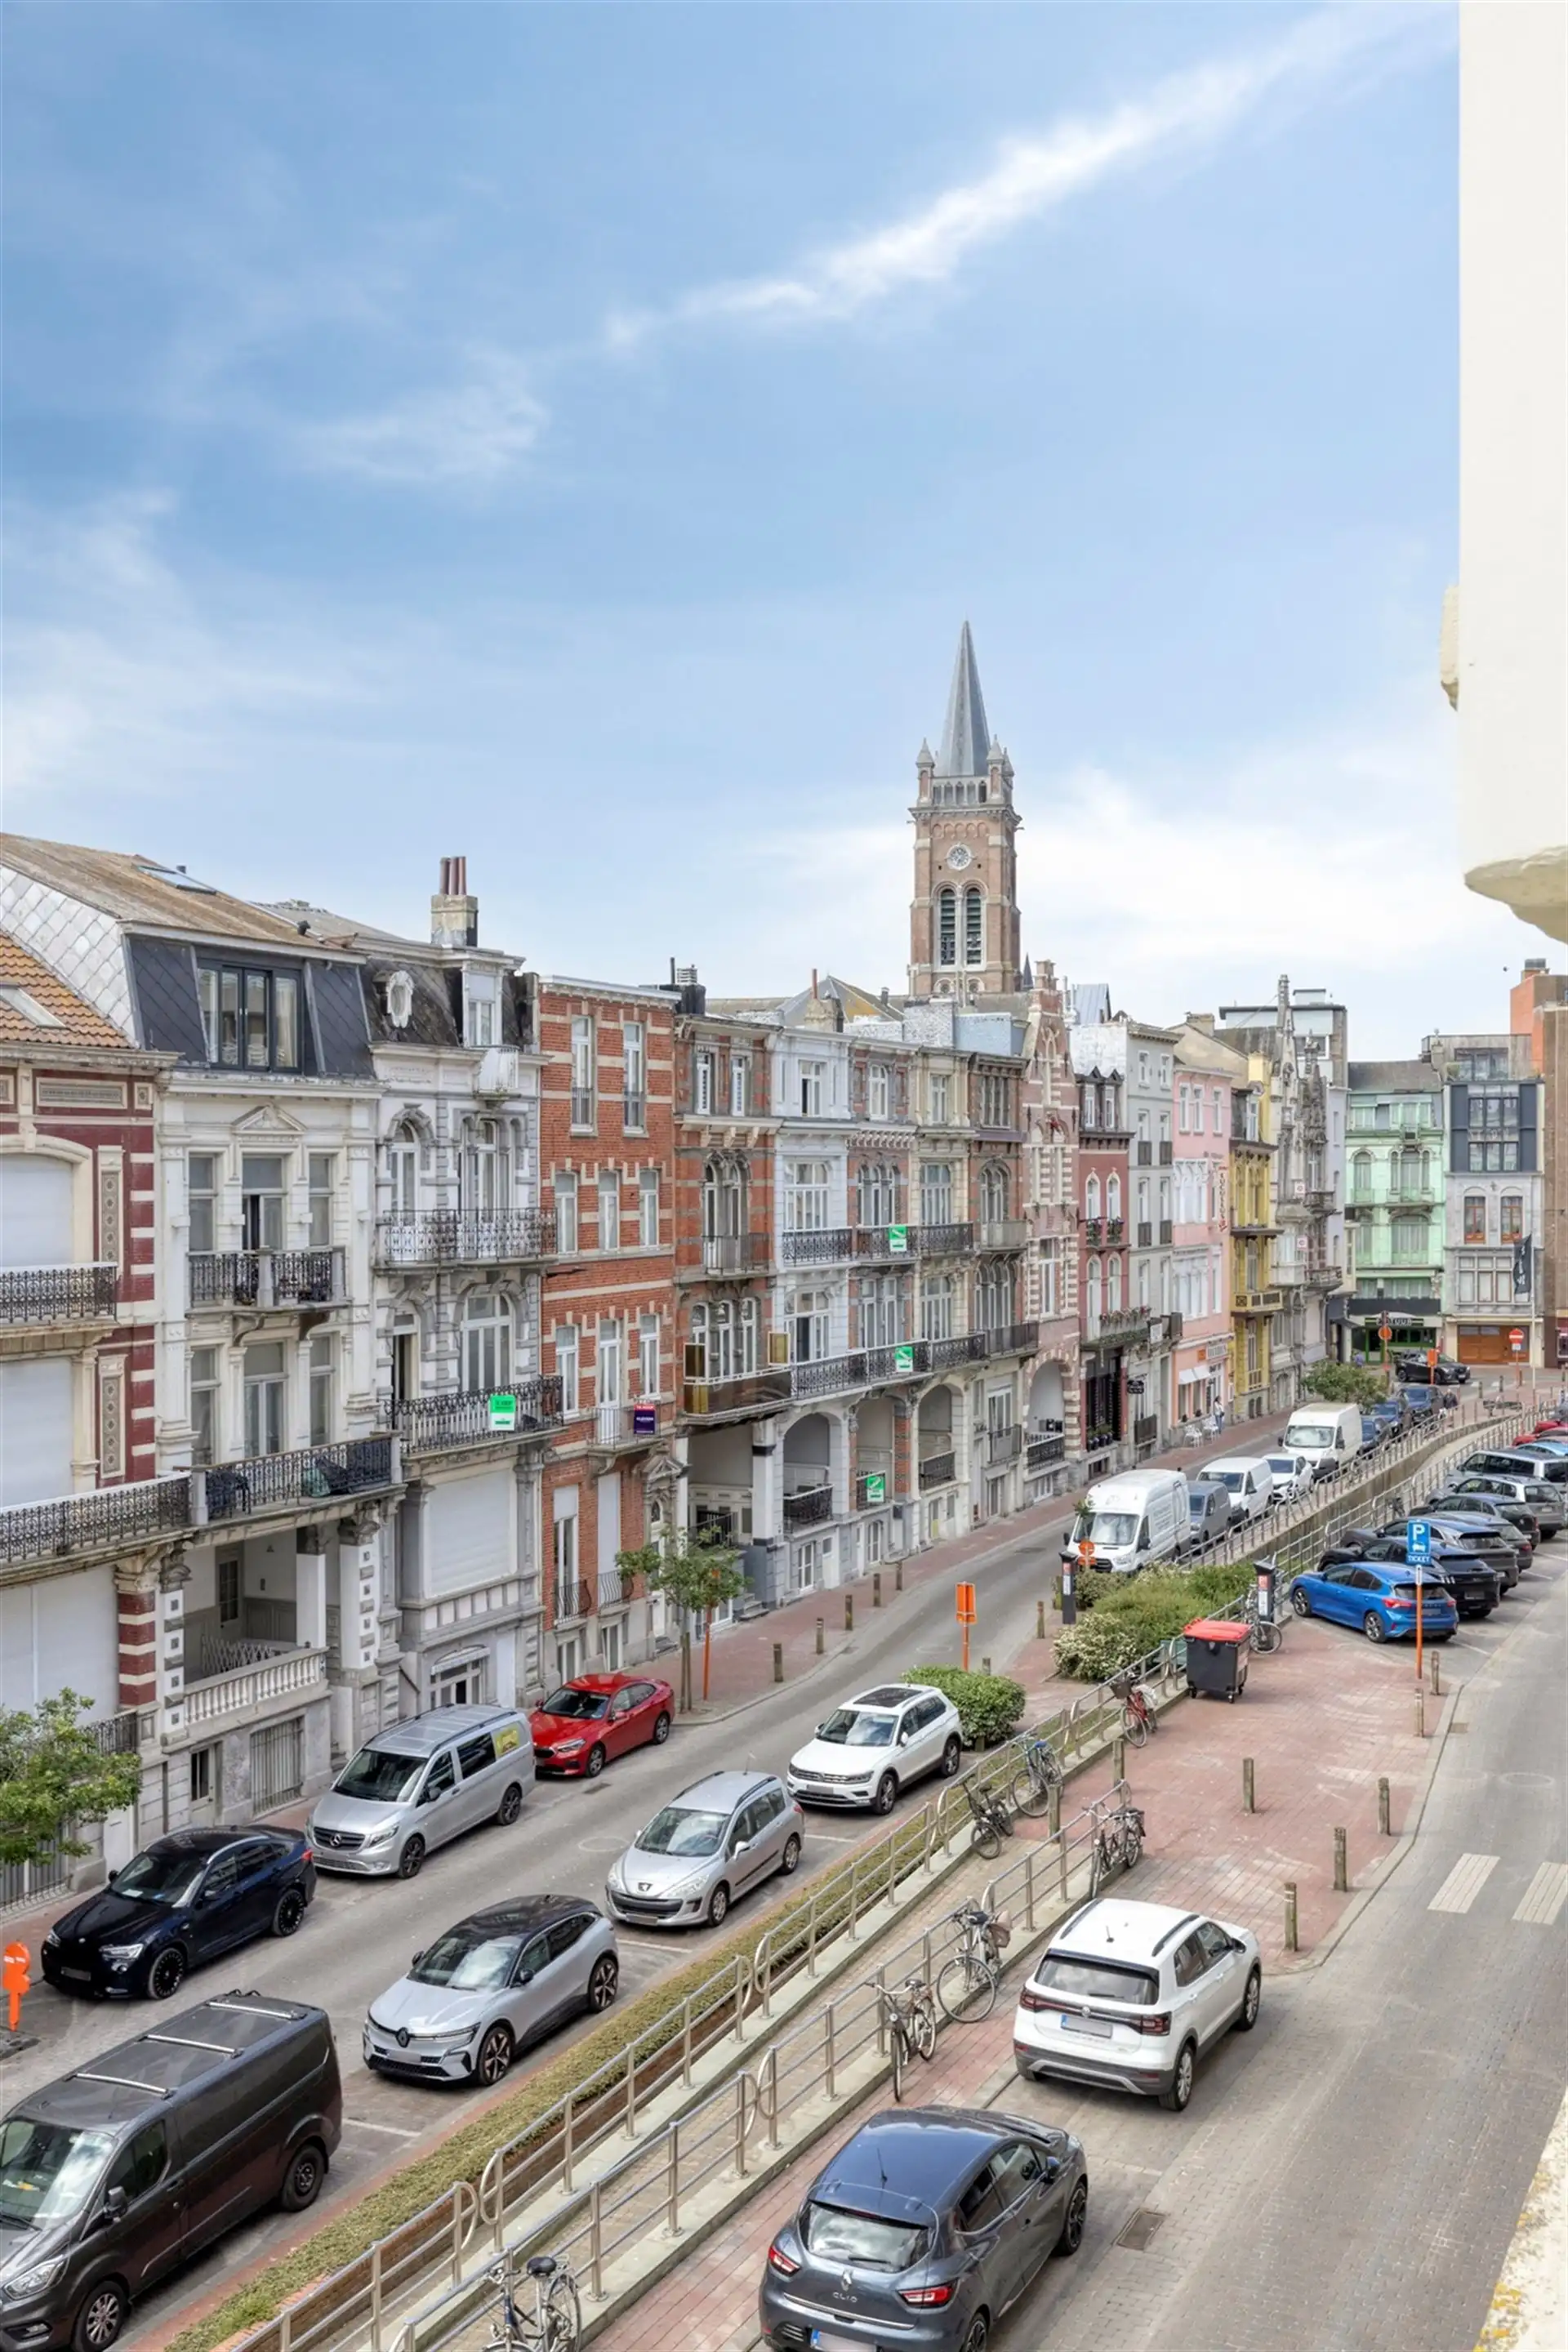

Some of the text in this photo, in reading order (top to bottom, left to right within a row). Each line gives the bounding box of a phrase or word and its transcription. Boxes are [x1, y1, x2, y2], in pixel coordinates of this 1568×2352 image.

[1413, 1524, 1425, 1541] P
[1408, 1554, 1430, 1562] TICKET
[832, 2292, 858, 2303] CLIO
